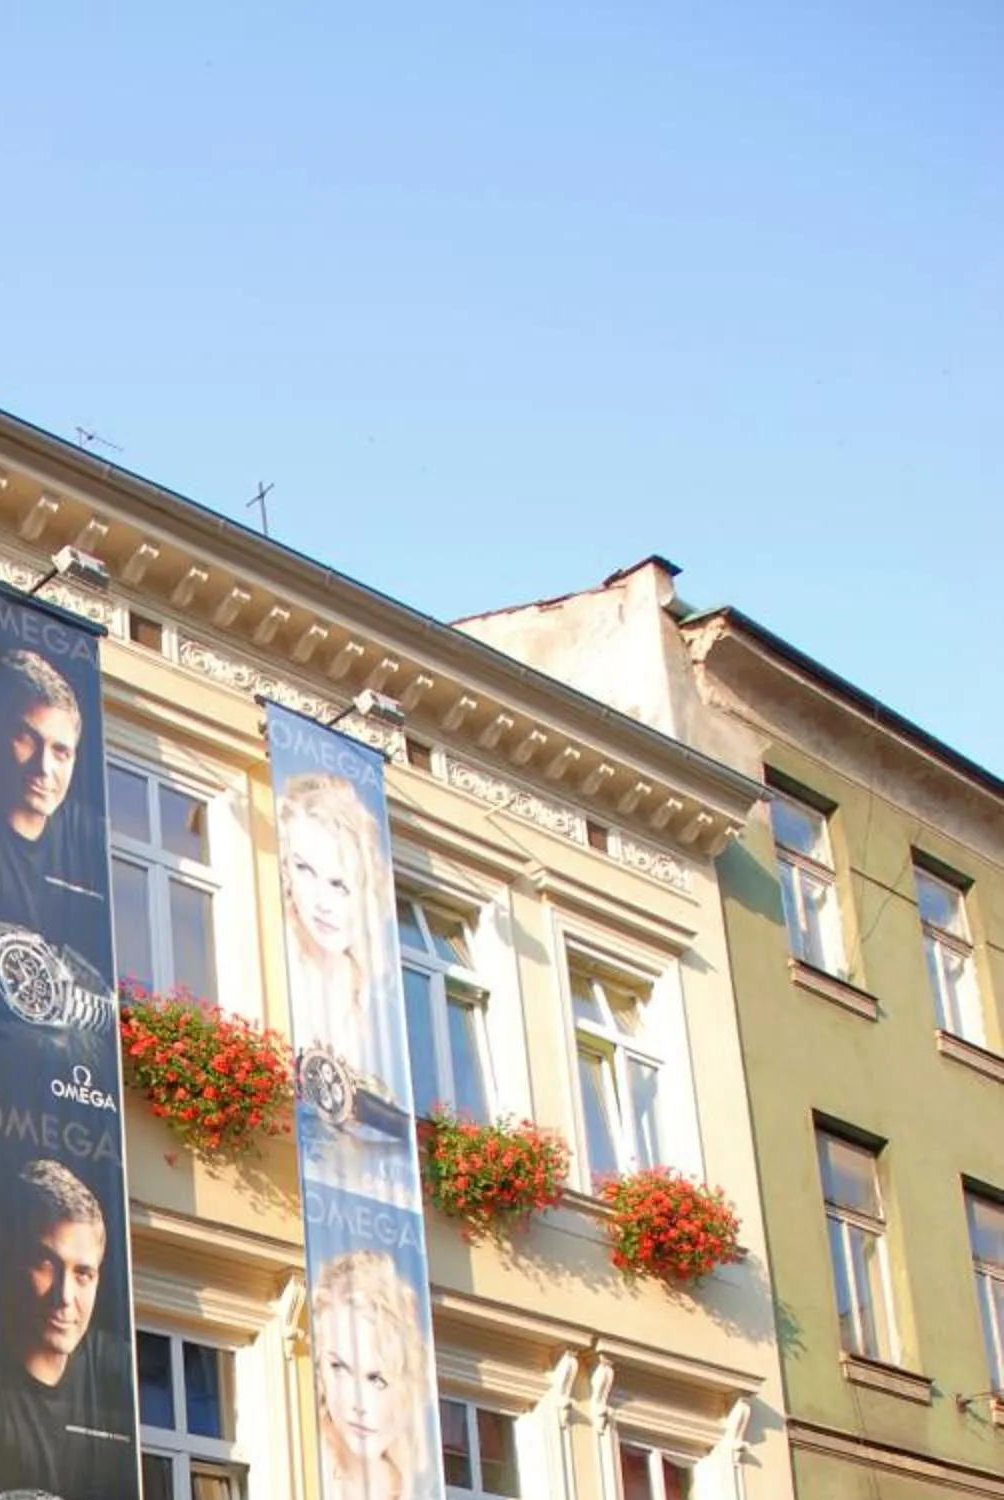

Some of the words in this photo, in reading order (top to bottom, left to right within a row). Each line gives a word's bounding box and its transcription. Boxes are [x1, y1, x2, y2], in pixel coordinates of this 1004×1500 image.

[271, 719, 380, 786] OMEGA
[50, 1079, 118, 1113] OMEGA
[305, 1190, 424, 1251] OMEGA
